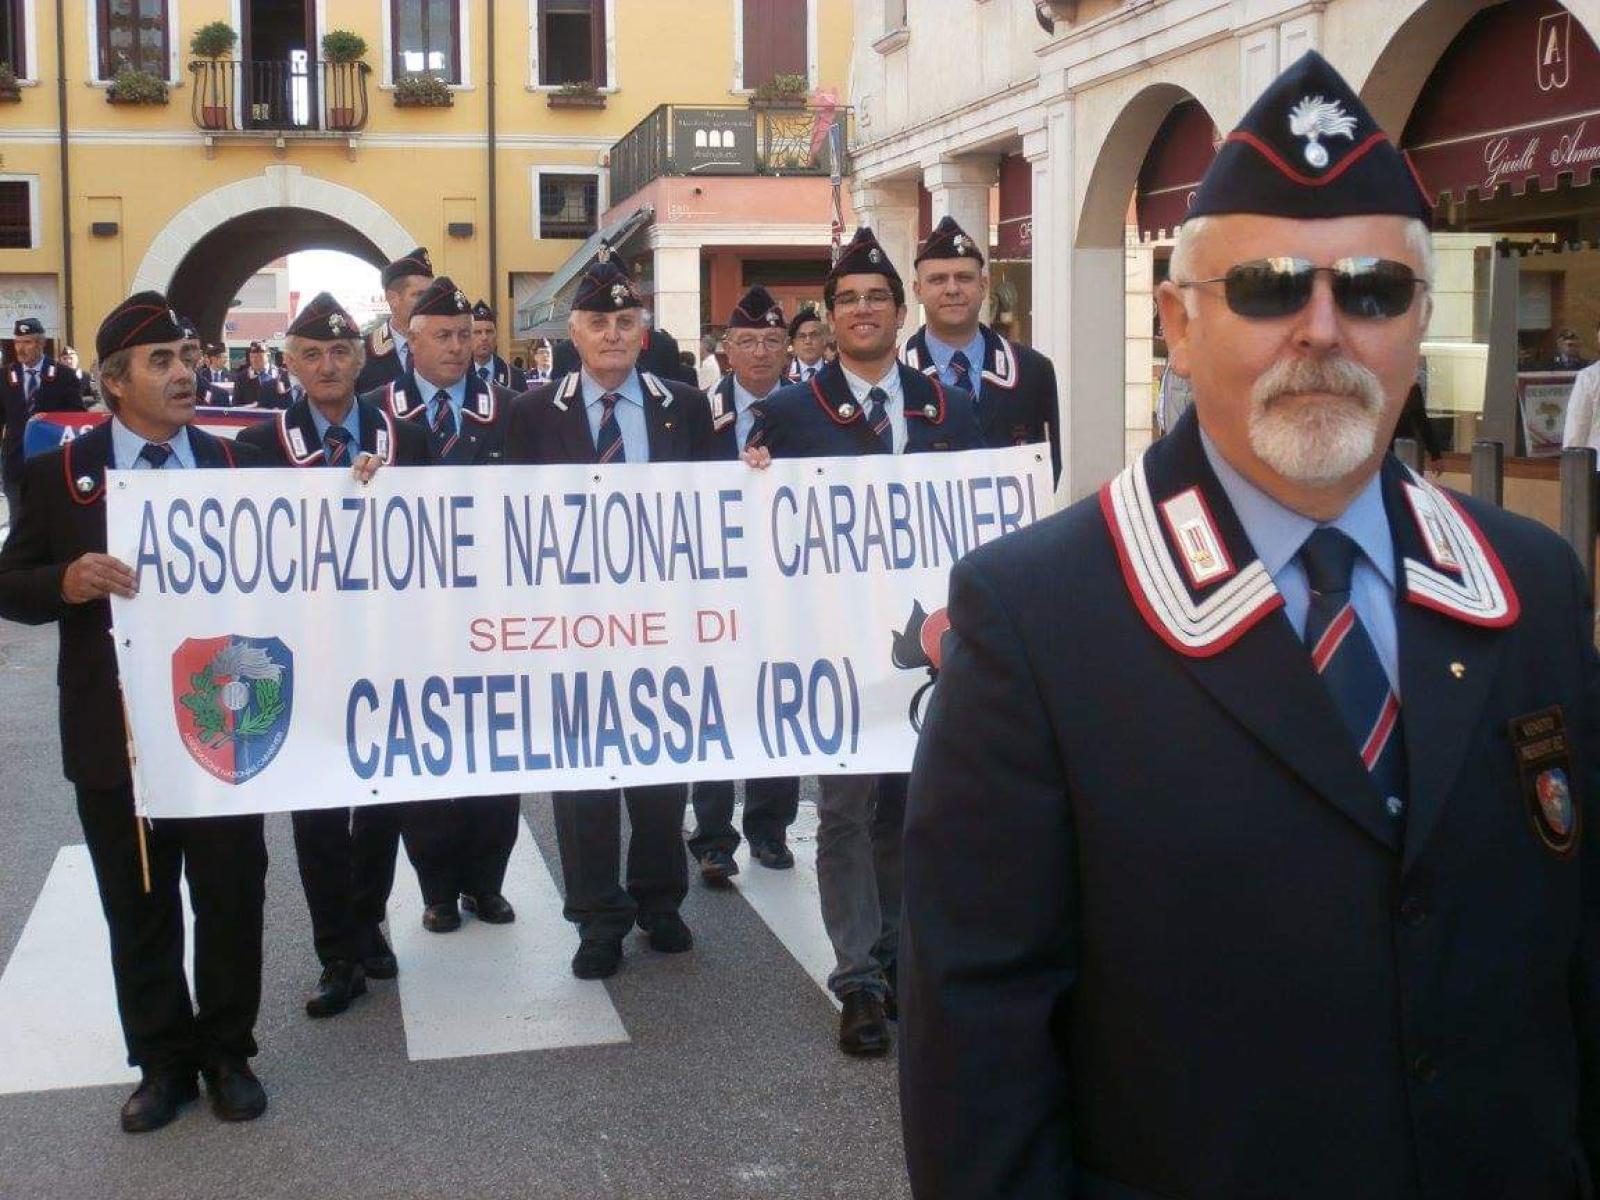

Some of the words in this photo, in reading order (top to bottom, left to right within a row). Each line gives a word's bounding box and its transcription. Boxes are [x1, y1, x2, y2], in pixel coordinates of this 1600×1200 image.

[135, 496, 477, 594] ASSOCIAZIONE
[503, 489, 748, 586] NAZIONALE
[469, 611, 669, 653] SEZIONE
[696, 609, 738, 644] DI
[346, 665, 735, 780] CASTELMASSA
[756, 656, 861, 759] (RO)
